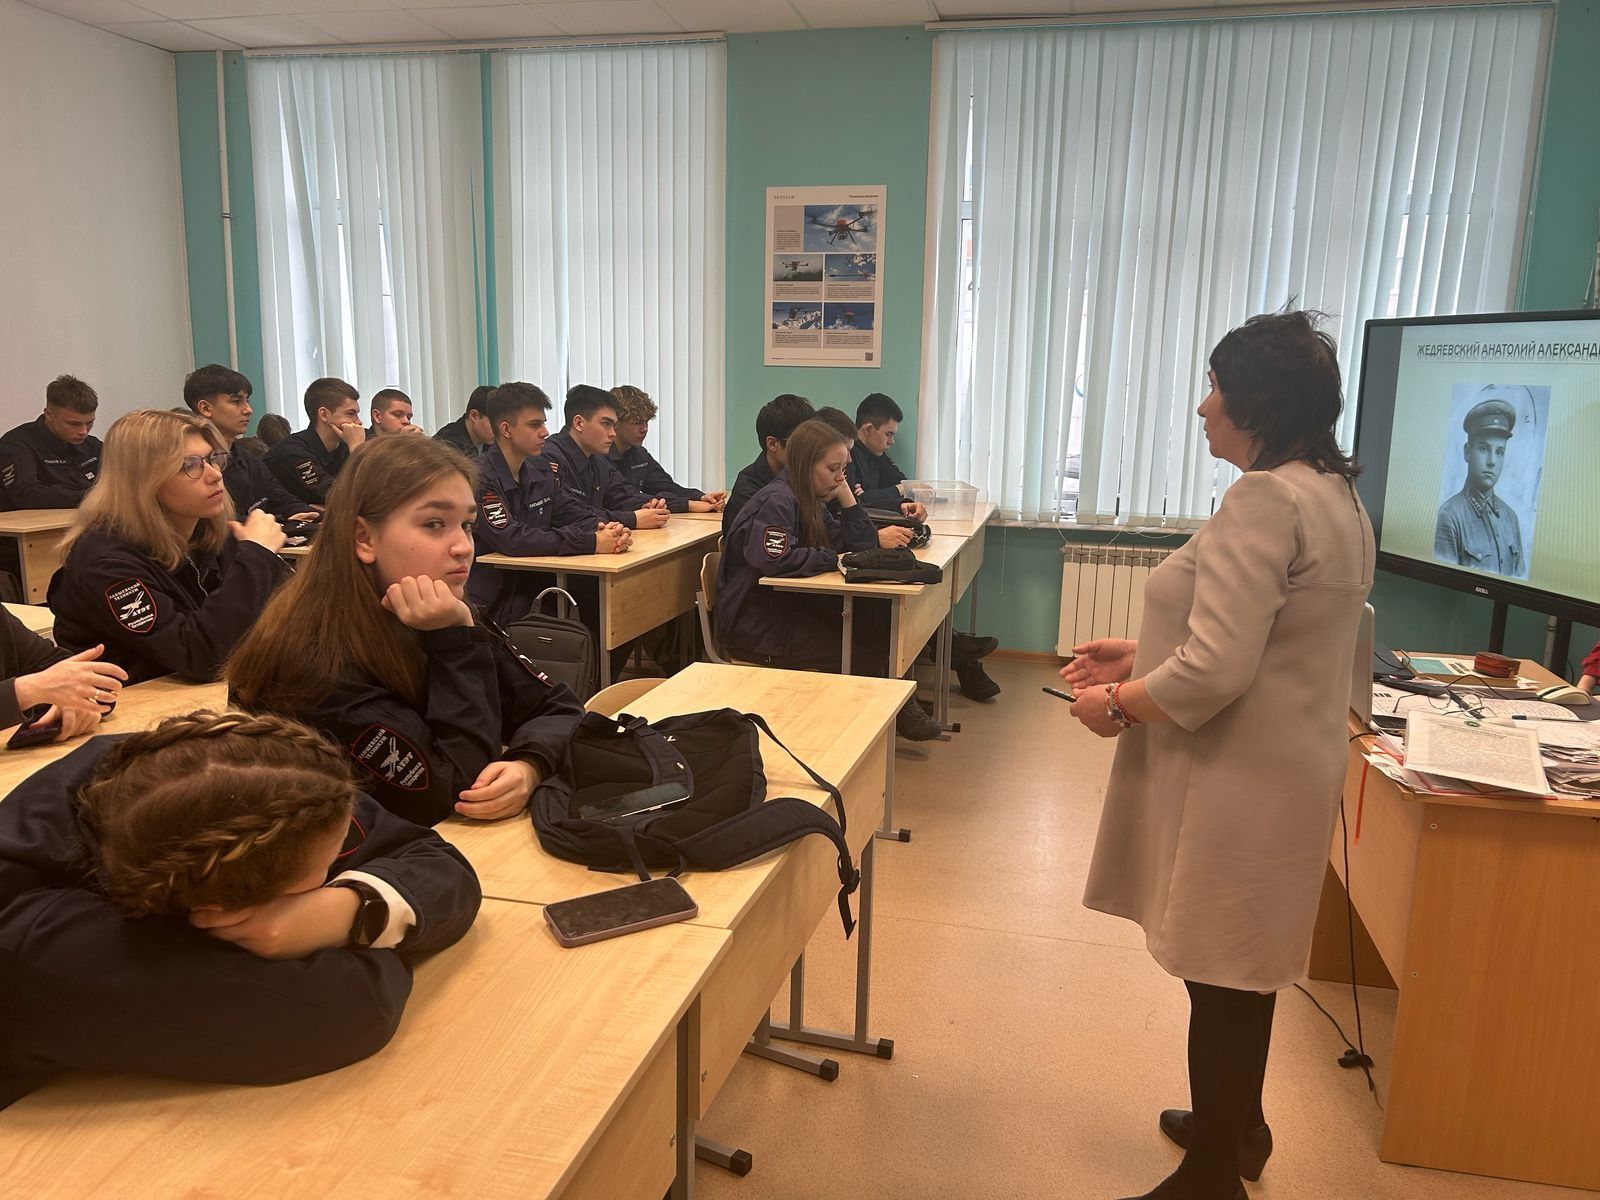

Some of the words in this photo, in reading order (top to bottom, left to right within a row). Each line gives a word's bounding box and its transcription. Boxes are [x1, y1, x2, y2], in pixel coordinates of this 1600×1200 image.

[1417, 341, 1480, 356] ЖЕДЯЕВСКИЙ
[1482, 340, 1536, 356] АНАТОЛИЙ
[1537, 342, 1600, 357] АЛЕКСАНД
